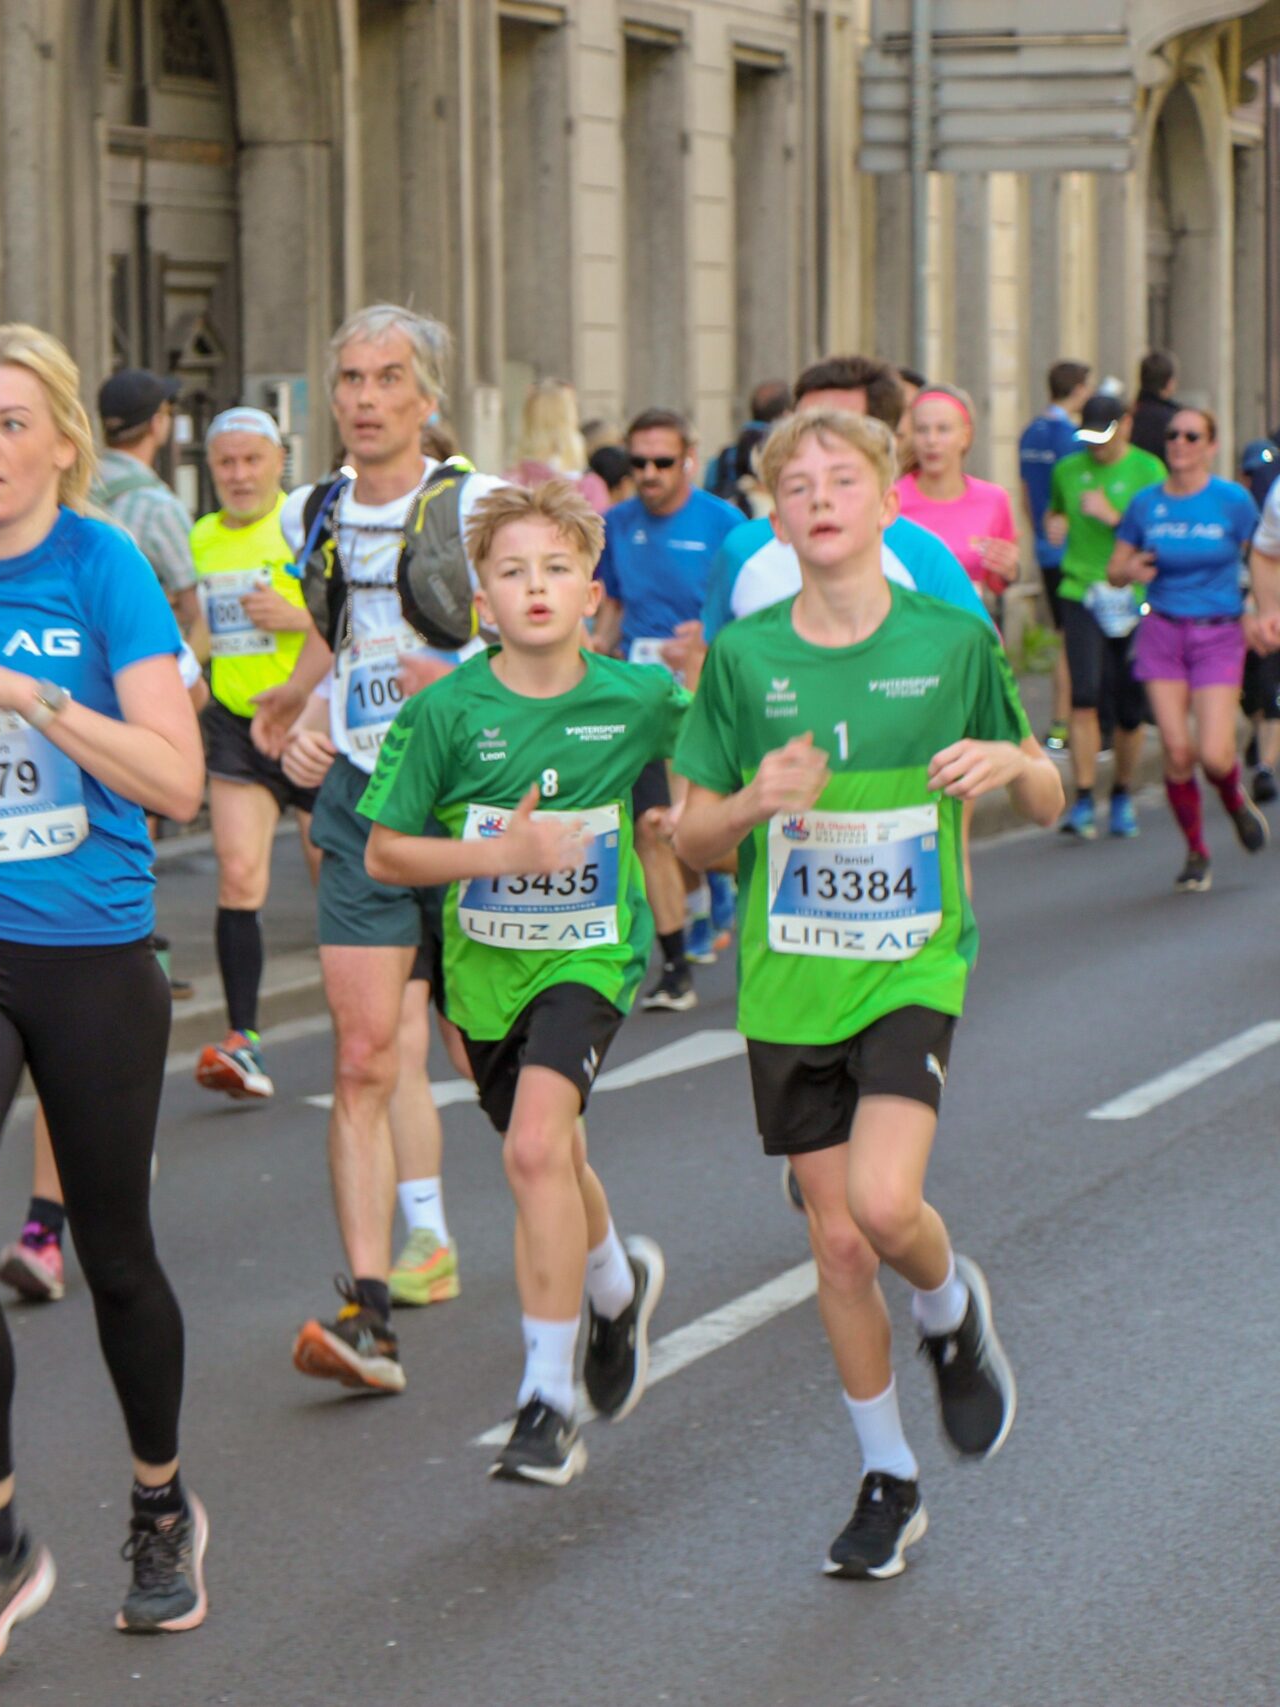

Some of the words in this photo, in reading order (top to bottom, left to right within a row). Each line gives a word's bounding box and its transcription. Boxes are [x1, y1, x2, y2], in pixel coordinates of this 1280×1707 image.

[2, 628, 81, 657] AG
[833, 720, 849, 761] 1
[480, 751, 506, 762] Leon
[541, 768, 558, 797] 8
[20, 823, 76, 849] AG
[834, 853, 874, 865] Daniel
[489, 863, 599, 896] 13435
[793, 865, 917, 902] 13384
[469, 917, 549, 941] LINZ
[558, 921, 606, 941] AG
[781, 924, 865, 951] LINZ
[876, 928, 929, 951] AG
